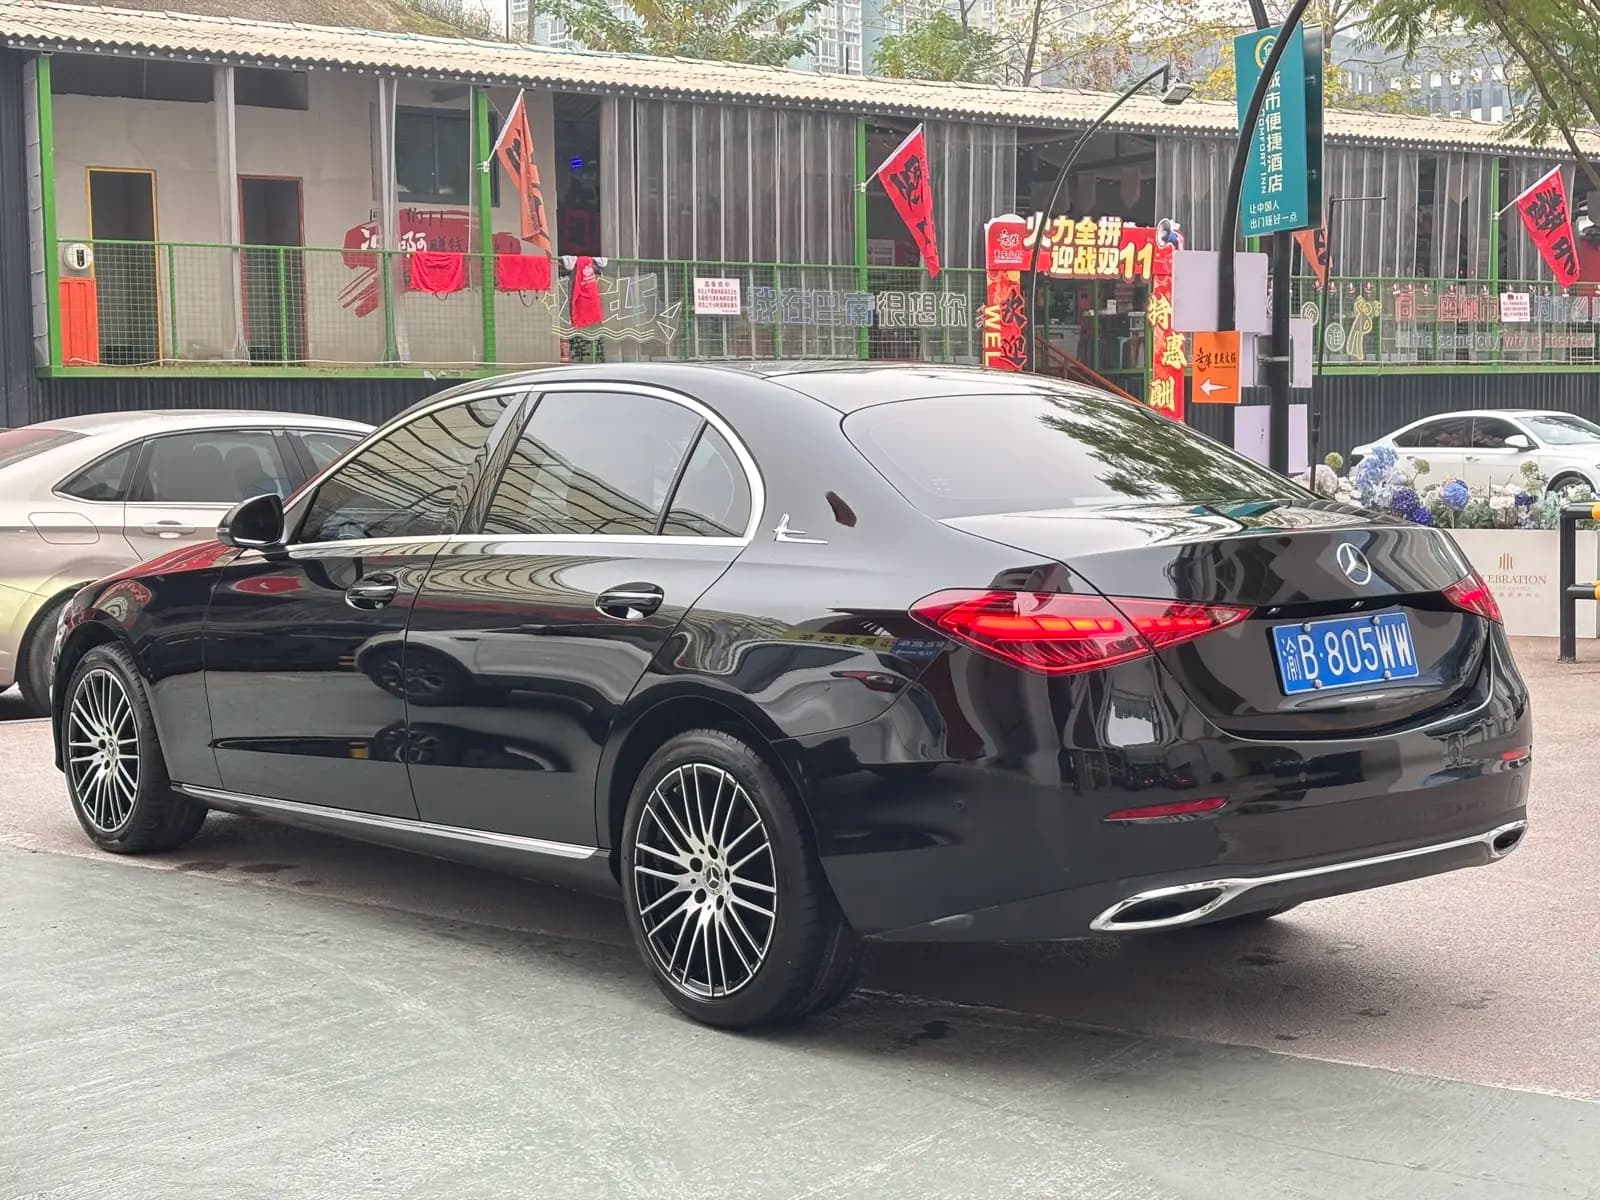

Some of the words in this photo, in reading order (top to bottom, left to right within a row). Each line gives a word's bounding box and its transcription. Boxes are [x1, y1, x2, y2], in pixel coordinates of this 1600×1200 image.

[1249, 200, 1280, 214] 让中国人
[1250, 211, 1298, 229] 出门睡好一点
[1023, 211, 1122, 247] 火力全拼
[1050, 241, 1153, 280] 迎战双11
[1000, 284, 1028, 368] 欢迎
